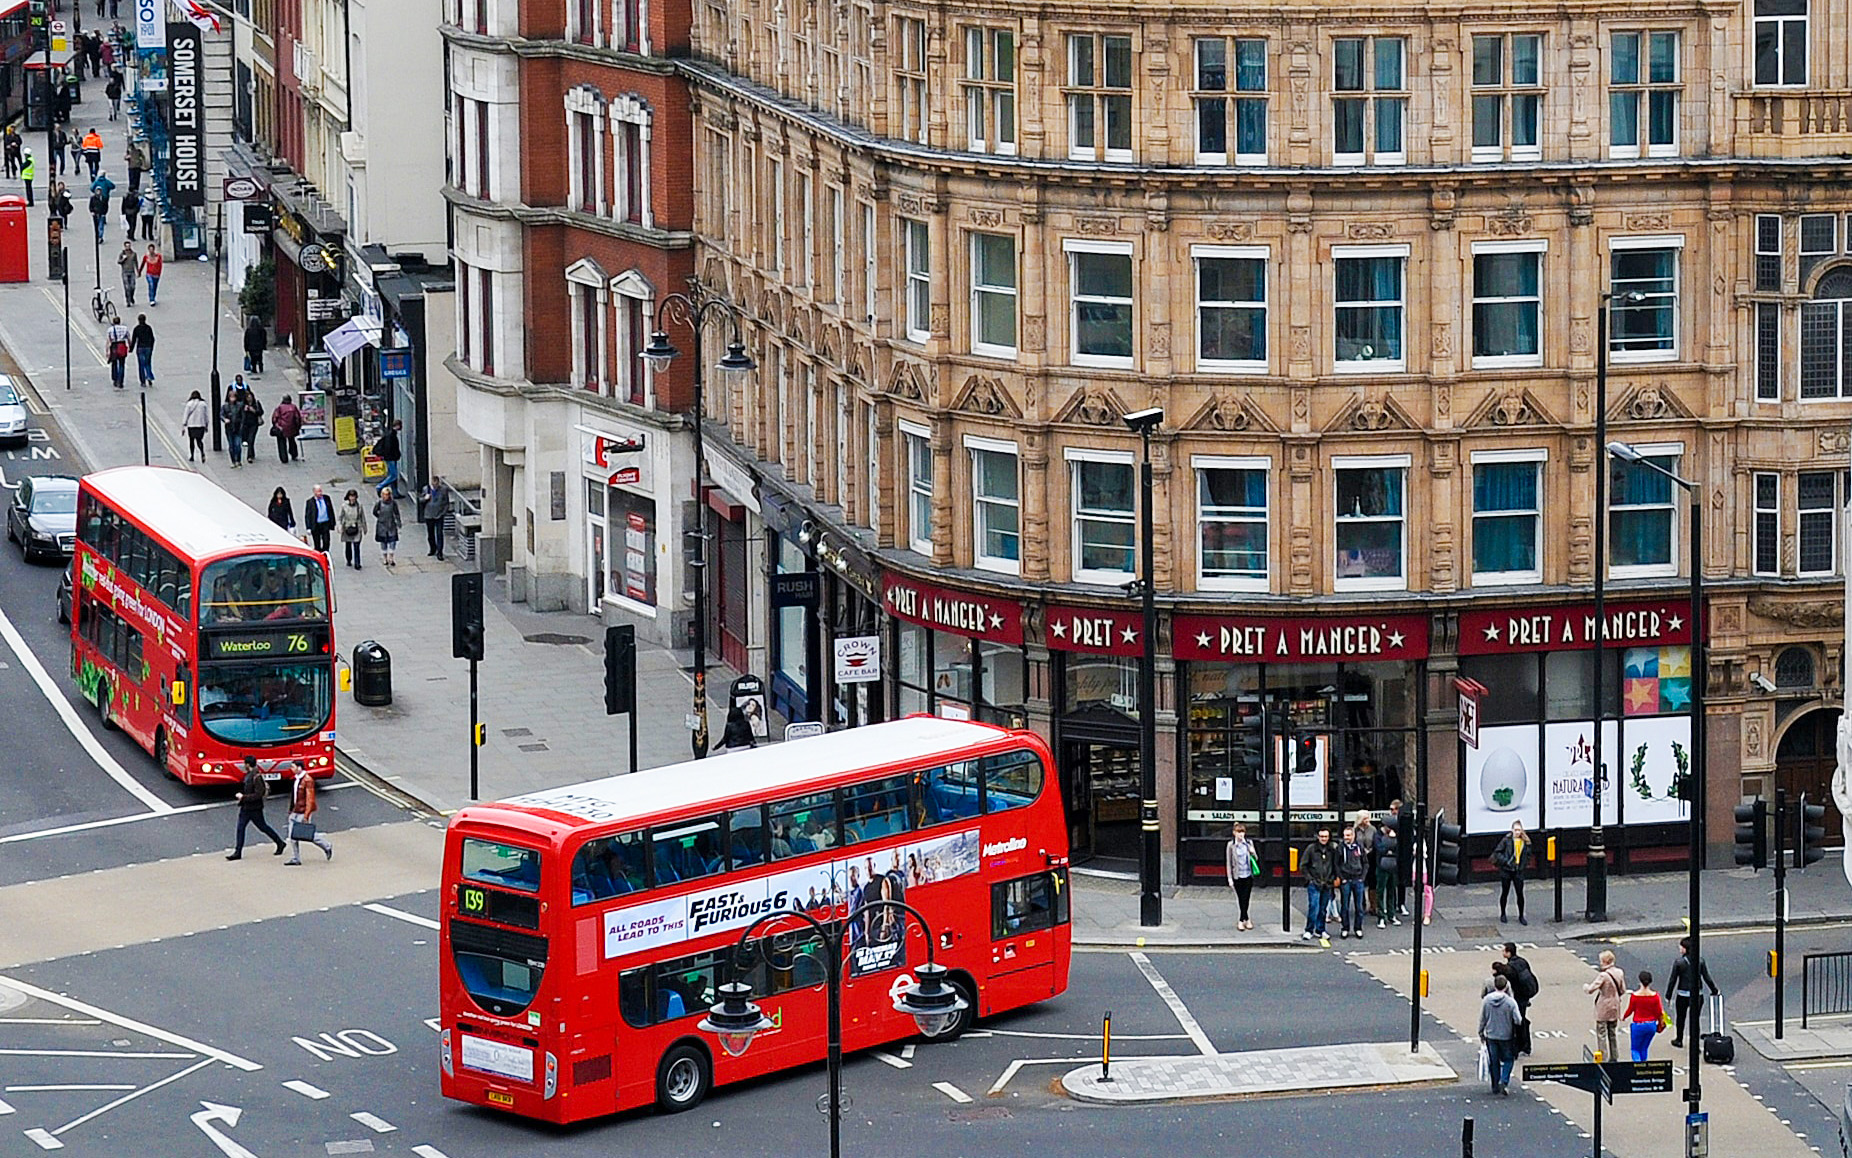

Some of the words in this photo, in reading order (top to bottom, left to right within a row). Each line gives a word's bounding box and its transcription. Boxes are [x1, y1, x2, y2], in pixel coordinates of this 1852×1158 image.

[173, 38, 196, 129] SOMERSET
[175, 134, 198, 192] HOUSE
[777, 580, 814, 595] RUSH
[894, 586, 918, 617] PRET
[921, 599, 931, 619] A
[934, 597, 986, 632] MANGER
[1072, 616, 1113, 647] PRET
[1509, 615, 1552, 645] PRET
[1562, 618, 1574, 643] A
[1585, 611, 1660, 641] MANGER
[220, 640, 271, 652] Waterloo
[288, 635, 308, 652] 76
[837, 637, 877, 658] CROWN
[1220, 626, 1266, 655] PRET
[1276, 627, 1289, 655] A
[1300, 626, 1382, 655] MANGER
[838, 669, 859, 677] CAFE
[1552, 778, 1585, 795] NATURA
[1212, 812, 1235, 820] SALADS
[983, 837, 1027, 857] Metroline
[465, 889, 484, 911] 139
[690, 891, 738, 919] FAST
[694, 898, 772, 932] FURIOUS
[773, 891, 788, 908] 6
[609, 924, 626, 935] ALL
[630, 915, 665, 930] ROADS
[618, 929, 643, 942] LEAD
[647, 926, 658, 936] TO
[663, 920, 684, 932] THIS
[291, 1029, 399, 1062] NO
